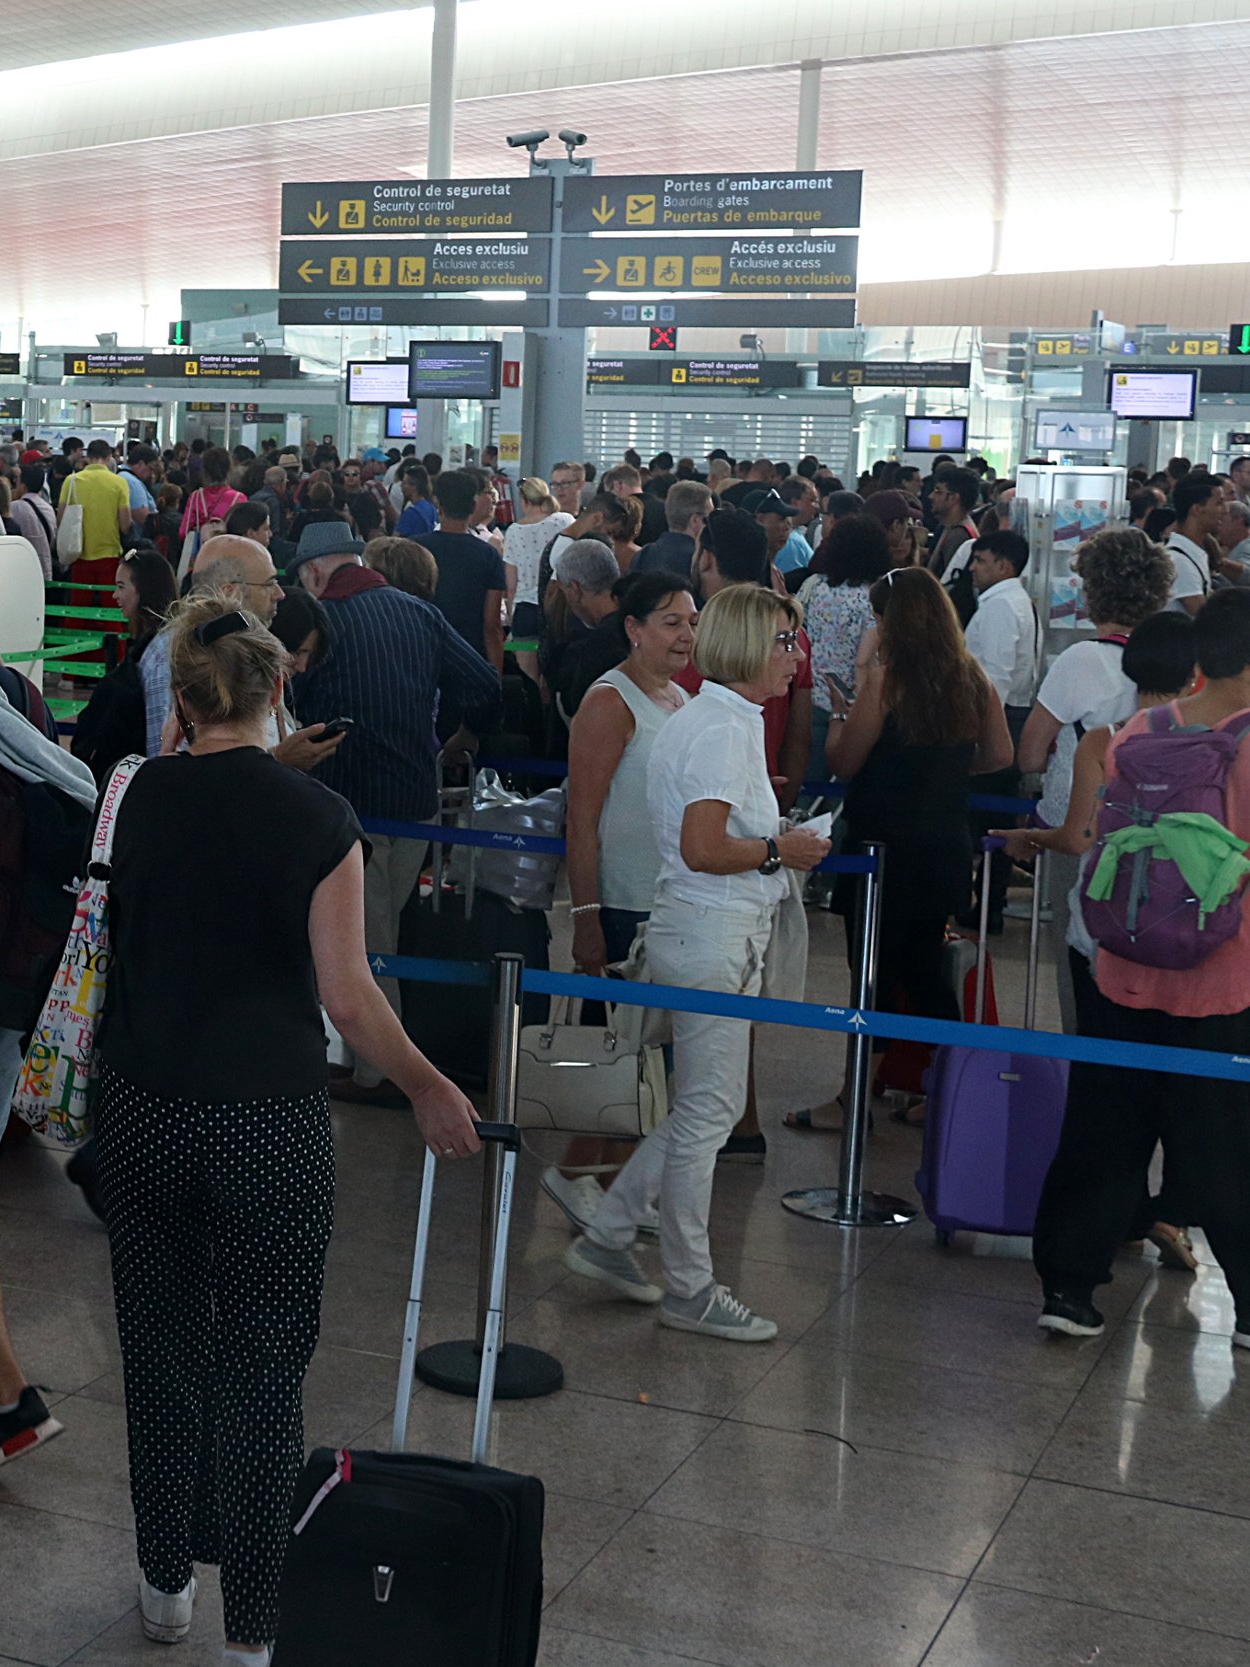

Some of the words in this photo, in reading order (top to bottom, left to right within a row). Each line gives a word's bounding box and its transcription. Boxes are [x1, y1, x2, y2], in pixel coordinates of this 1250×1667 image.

[664, 179, 711, 192] Portes
[716, 176, 833, 191] d'embarcament
[373, 185, 421, 198] Control
[425, 184, 441, 197] de
[446, 184, 511, 199] seguretat
[373, 200, 415, 213] Security
[418, 200, 455, 211] control
[663, 195, 713, 208] Boarding
[717, 195, 750, 208] gates
[373, 214, 420, 227] Control
[425, 214, 440, 226] de
[445, 212, 512, 228] seguridad
[663, 210, 719, 223] Puertas
[724, 210, 741, 222] de
[747, 209, 822, 224] embarque
[475, 242, 528, 255] exclusiu
[777, 240, 836, 253] exclusiu
[432, 258, 478, 269] Exclusive
[480, 260, 515, 270] access
[729, 257, 779, 269] Exclusive
[782, 258, 821, 268] access
[693, 267, 719, 276] CREW
[432, 272, 479, 285] Acceso
[482, 272, 543, 285] exclusivo
[729, 272, 781, 285] Acceso
[784, 272, 851, 285] exclusivo
[689, 361, 714, 369] Control
[94, 771, 128, 851] Broadway
[824, 1006, 845, 1015] Aena
